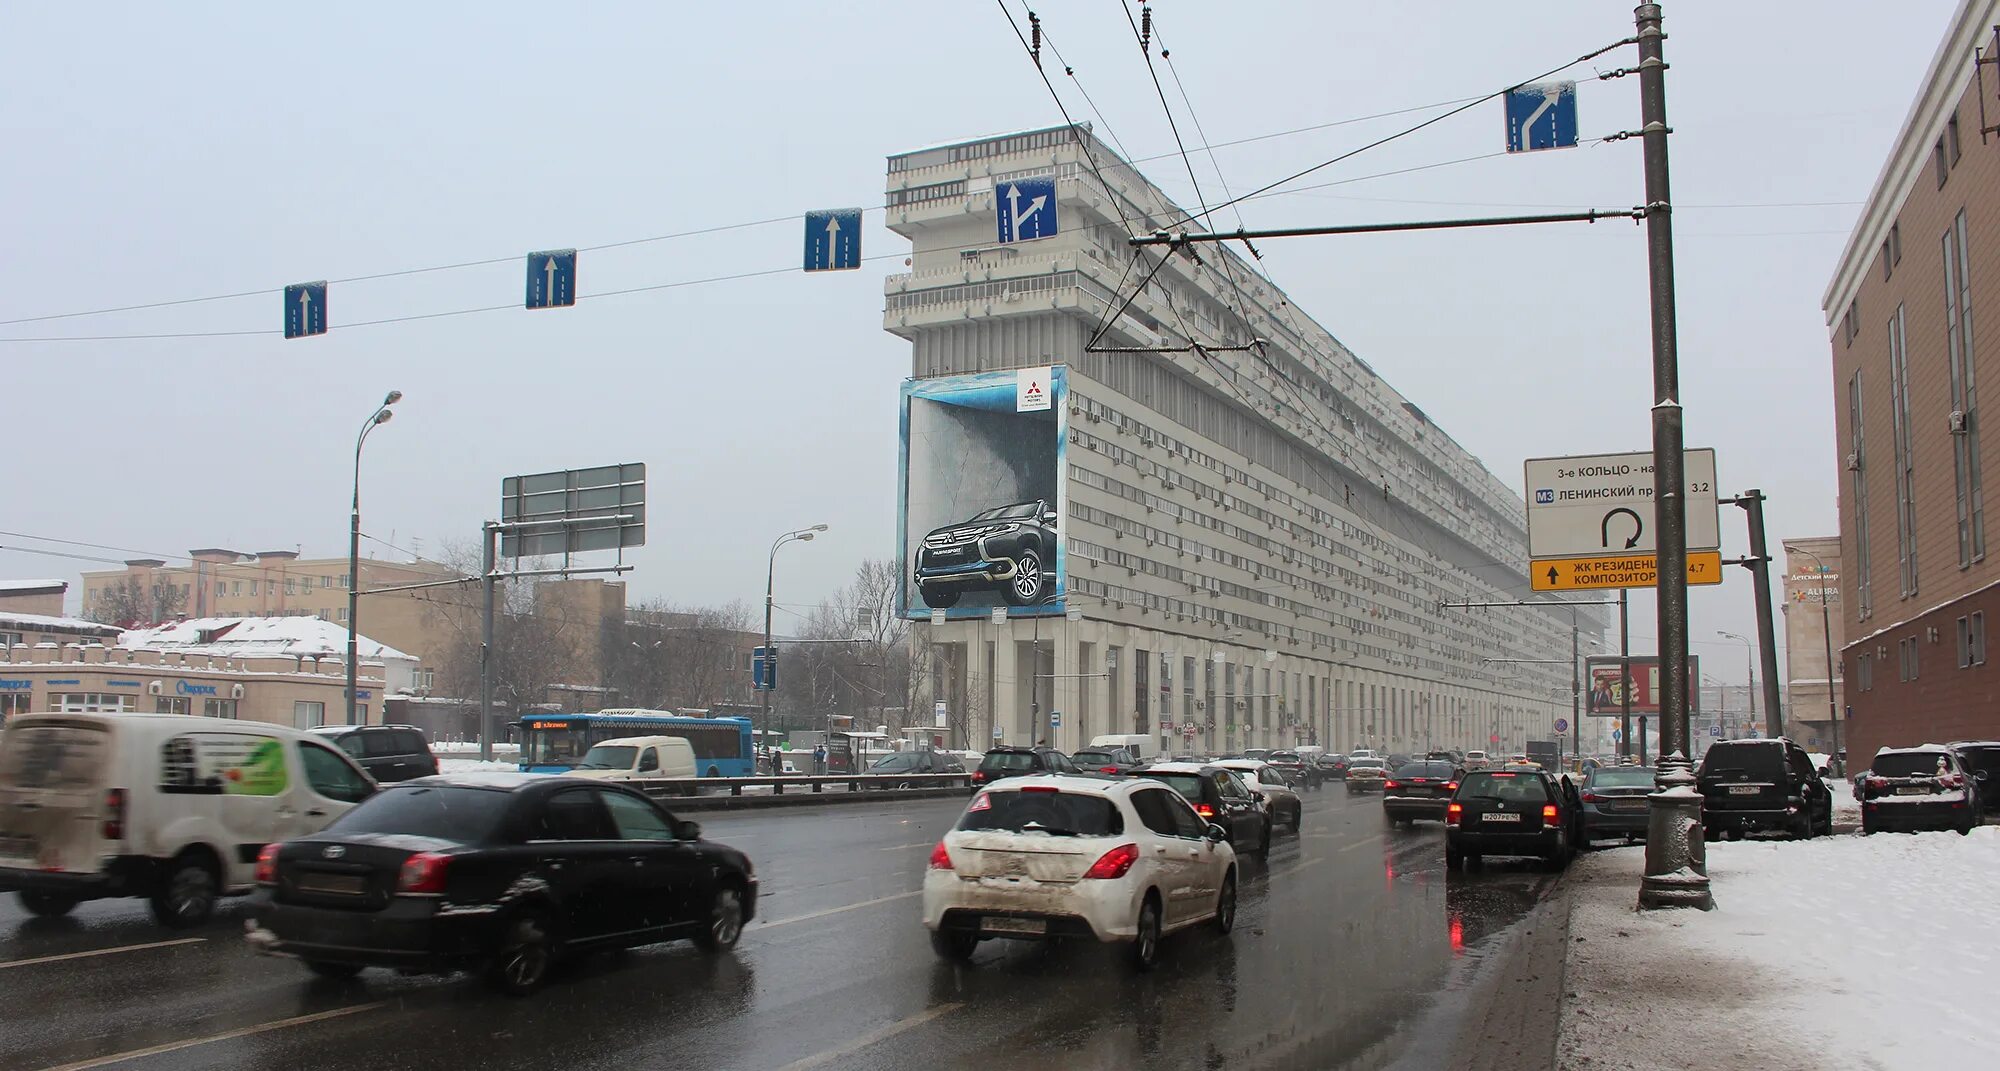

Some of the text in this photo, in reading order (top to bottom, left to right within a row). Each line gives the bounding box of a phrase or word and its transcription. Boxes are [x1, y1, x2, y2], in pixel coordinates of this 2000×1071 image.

[1558, 468, 1575, 478] 3-е
[1578, 464, 1630, 477] КОЛЬЦО
[1640, 465, 1655, 474] на
[1536, 491, 1554, 502] М3
[1559, 484, 1634, 500] ЛЕНИНСКИЙ
[1692, 482, 1709, 492] 3.2
[1574, 562, 1591, 572] ЖК
[1688, 564, 1704, 572] 4.7
[1574, 572, 1656, 584] КОМПОЗИТОР
